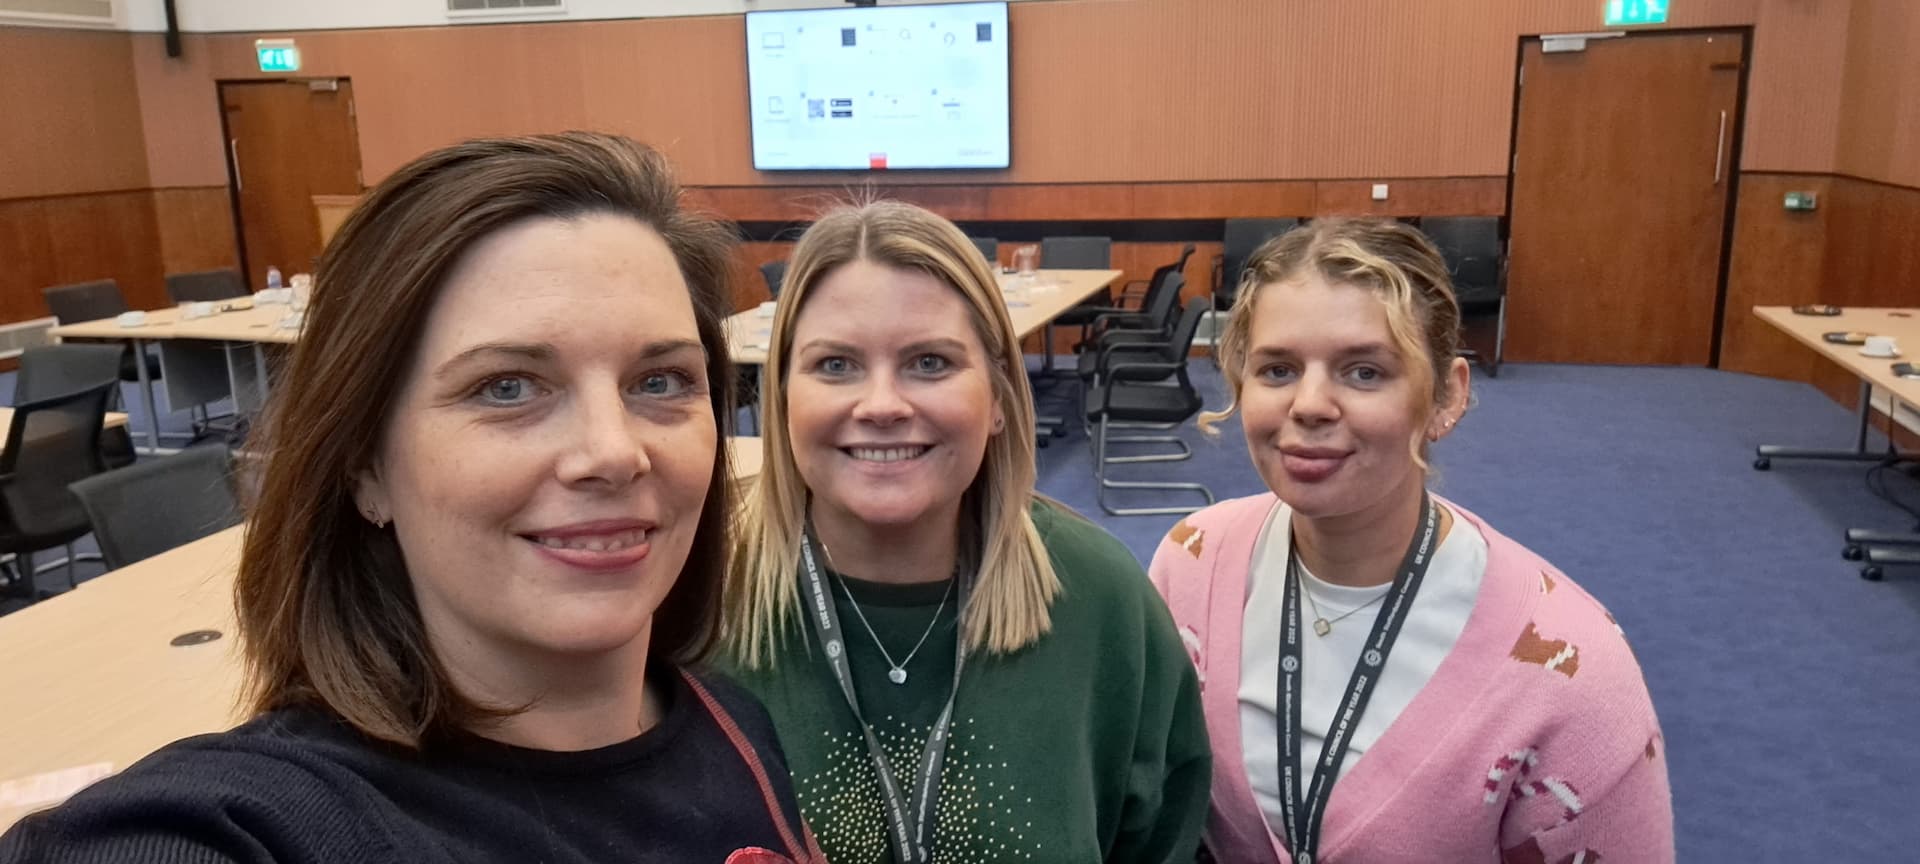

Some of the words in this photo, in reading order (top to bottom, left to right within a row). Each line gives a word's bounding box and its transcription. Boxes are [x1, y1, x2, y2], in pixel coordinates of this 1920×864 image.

[1418, 526, 1433, 554] COUNCIL
[802, 544, 815, 572] COUNCIL
[812, 581, 821, 593] THE
[815, 593, 826, 610] YEAR
[820, 610, 831, 629] 2022
[1328, 728, 1344, 756] COUNCIL
[1343, 707, 1353, 720] THE
[1349, 691, 1360, 708] YEAR
[1355, 674, 1367, 693] 2022
